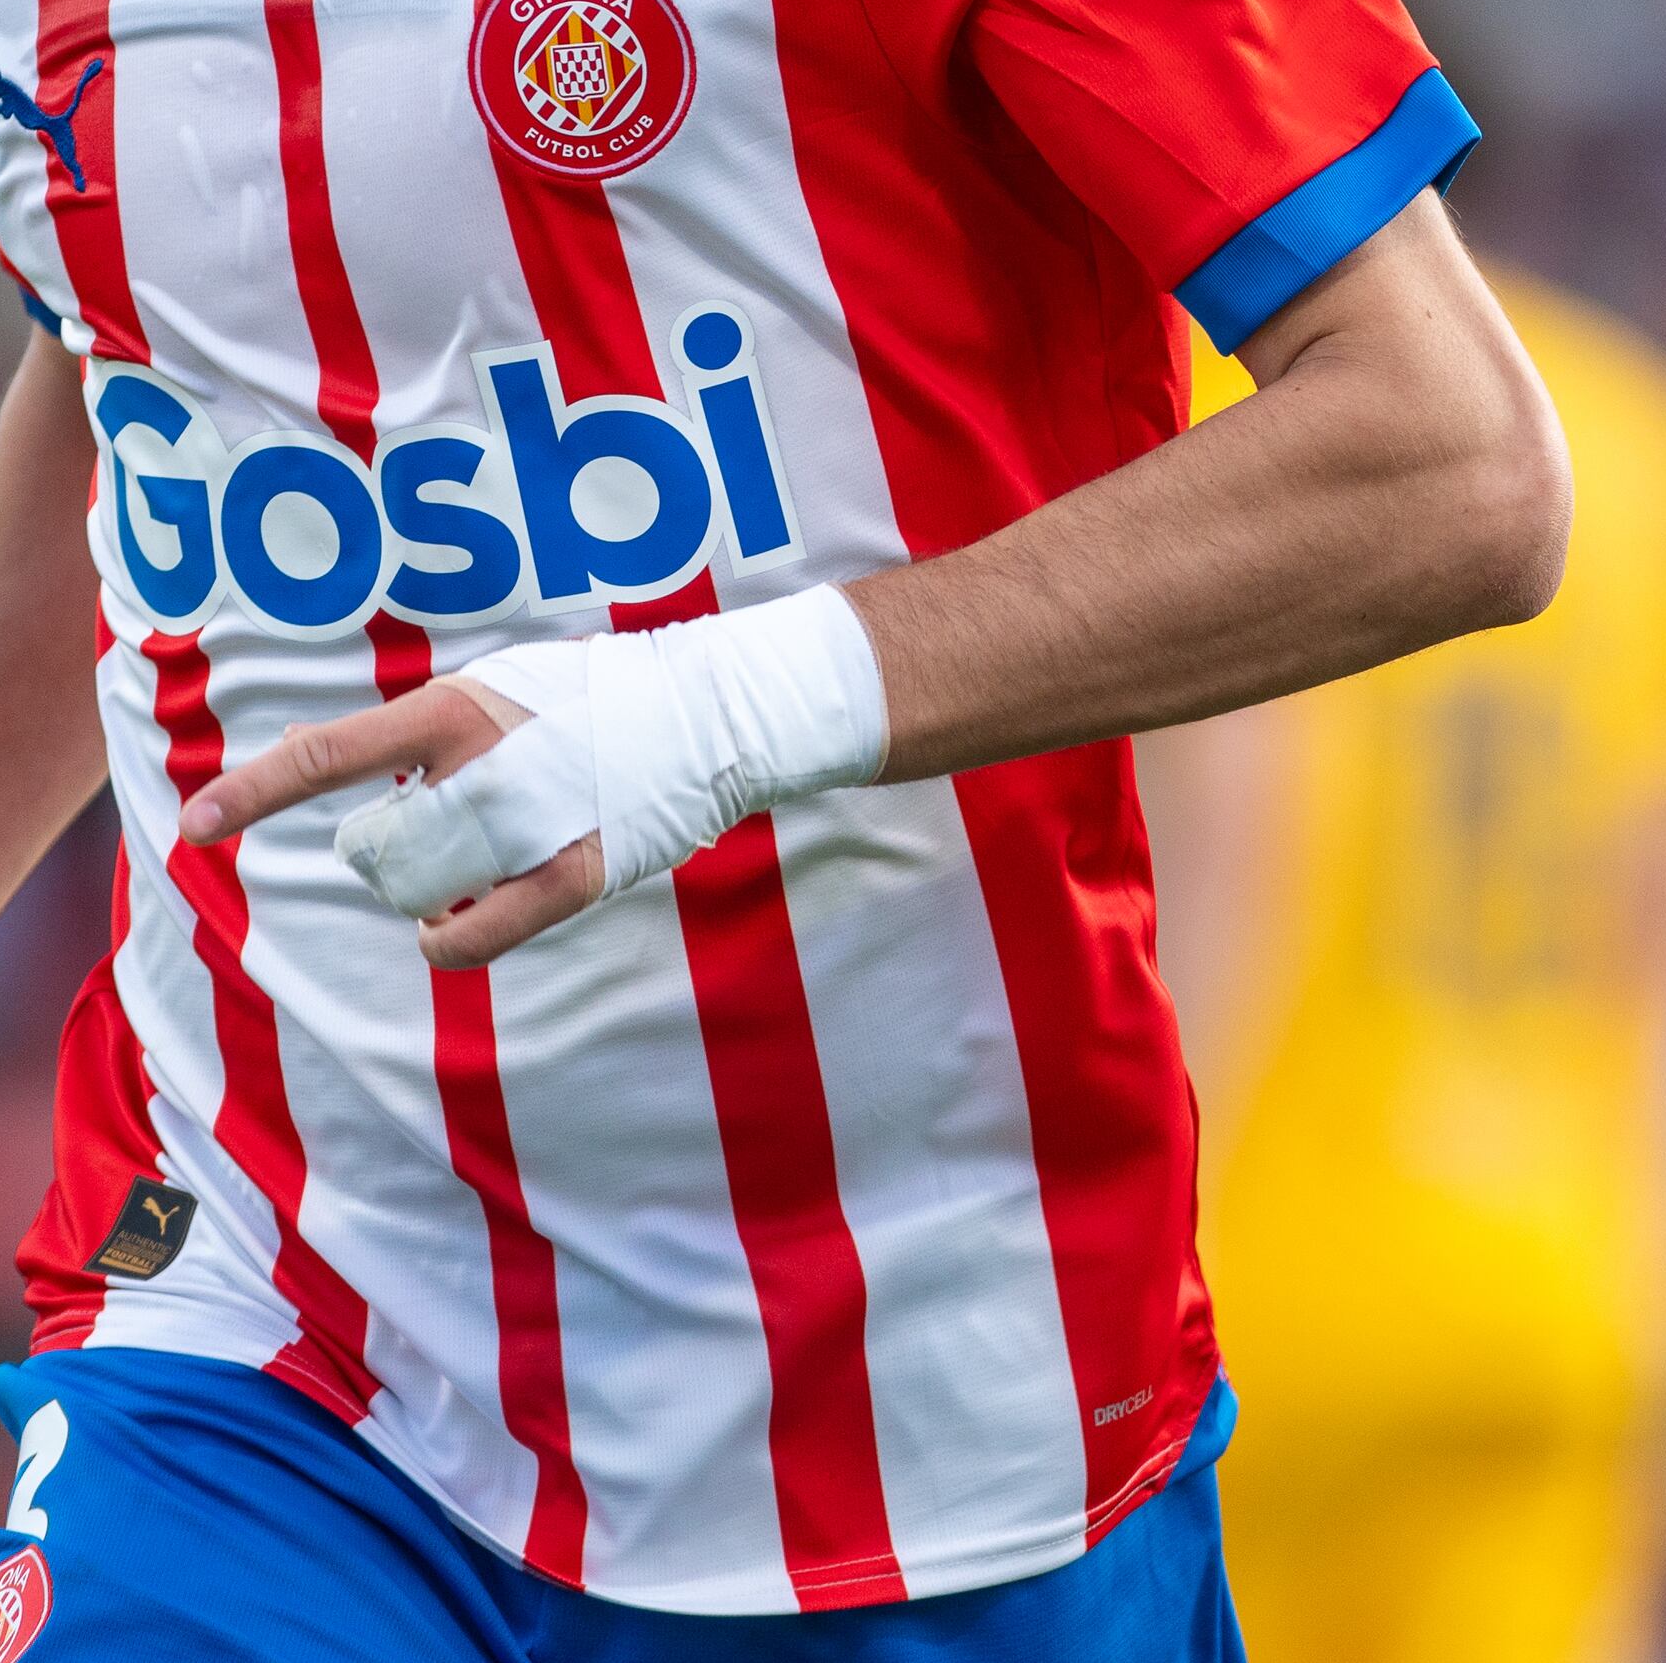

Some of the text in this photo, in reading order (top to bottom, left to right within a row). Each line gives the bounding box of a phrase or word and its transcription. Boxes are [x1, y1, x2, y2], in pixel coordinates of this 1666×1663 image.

[524, 114, 654, 159] FUTBOL CLUB
[95, 311, 792, 628] Gosbi
[104, 1247, 157, 1272] FOOTBALL
[117, 1230, 172, 1254] AUTHENTIC
[1094, 1385, 1154, 1427] DRYCELL
